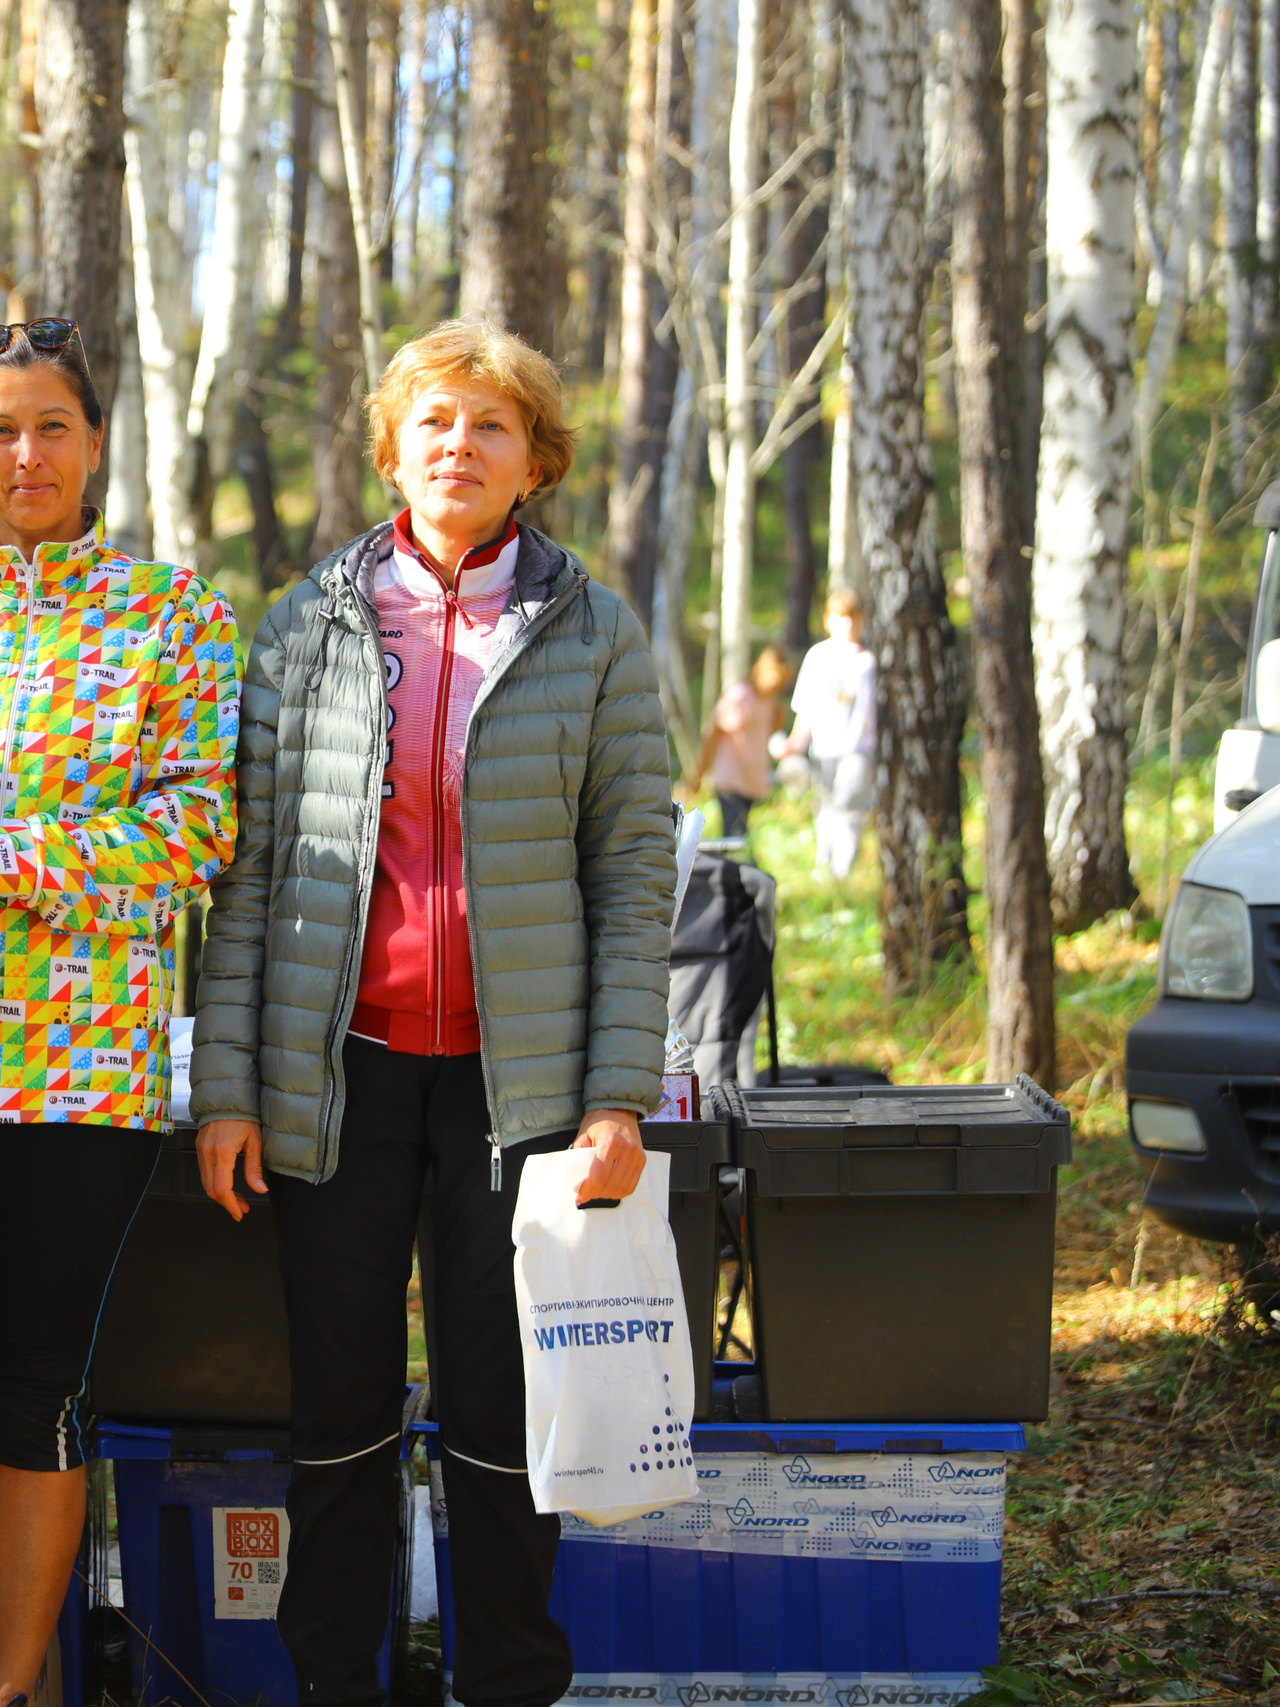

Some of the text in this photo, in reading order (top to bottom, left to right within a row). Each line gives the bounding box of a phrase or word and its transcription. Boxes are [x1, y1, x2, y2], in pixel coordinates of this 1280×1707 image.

[676, 1097, 687, 1119] 1
[646, 1297, 675, 1307] ЦЕНТР
[553, 1466, 604, 1478] wintersport45.ru
[800, 1475, 866, 1484] NORD
[744, 1517, 810, 1527] NORD
[899, 1514, 967, 1524] NORD
[231, 1520, 274, 1534] ROX
[231, 1536, 274, 1550] BOX
[228, 1562, 253, 1579] 70
[712, 1689, 816, 1703] NORD
